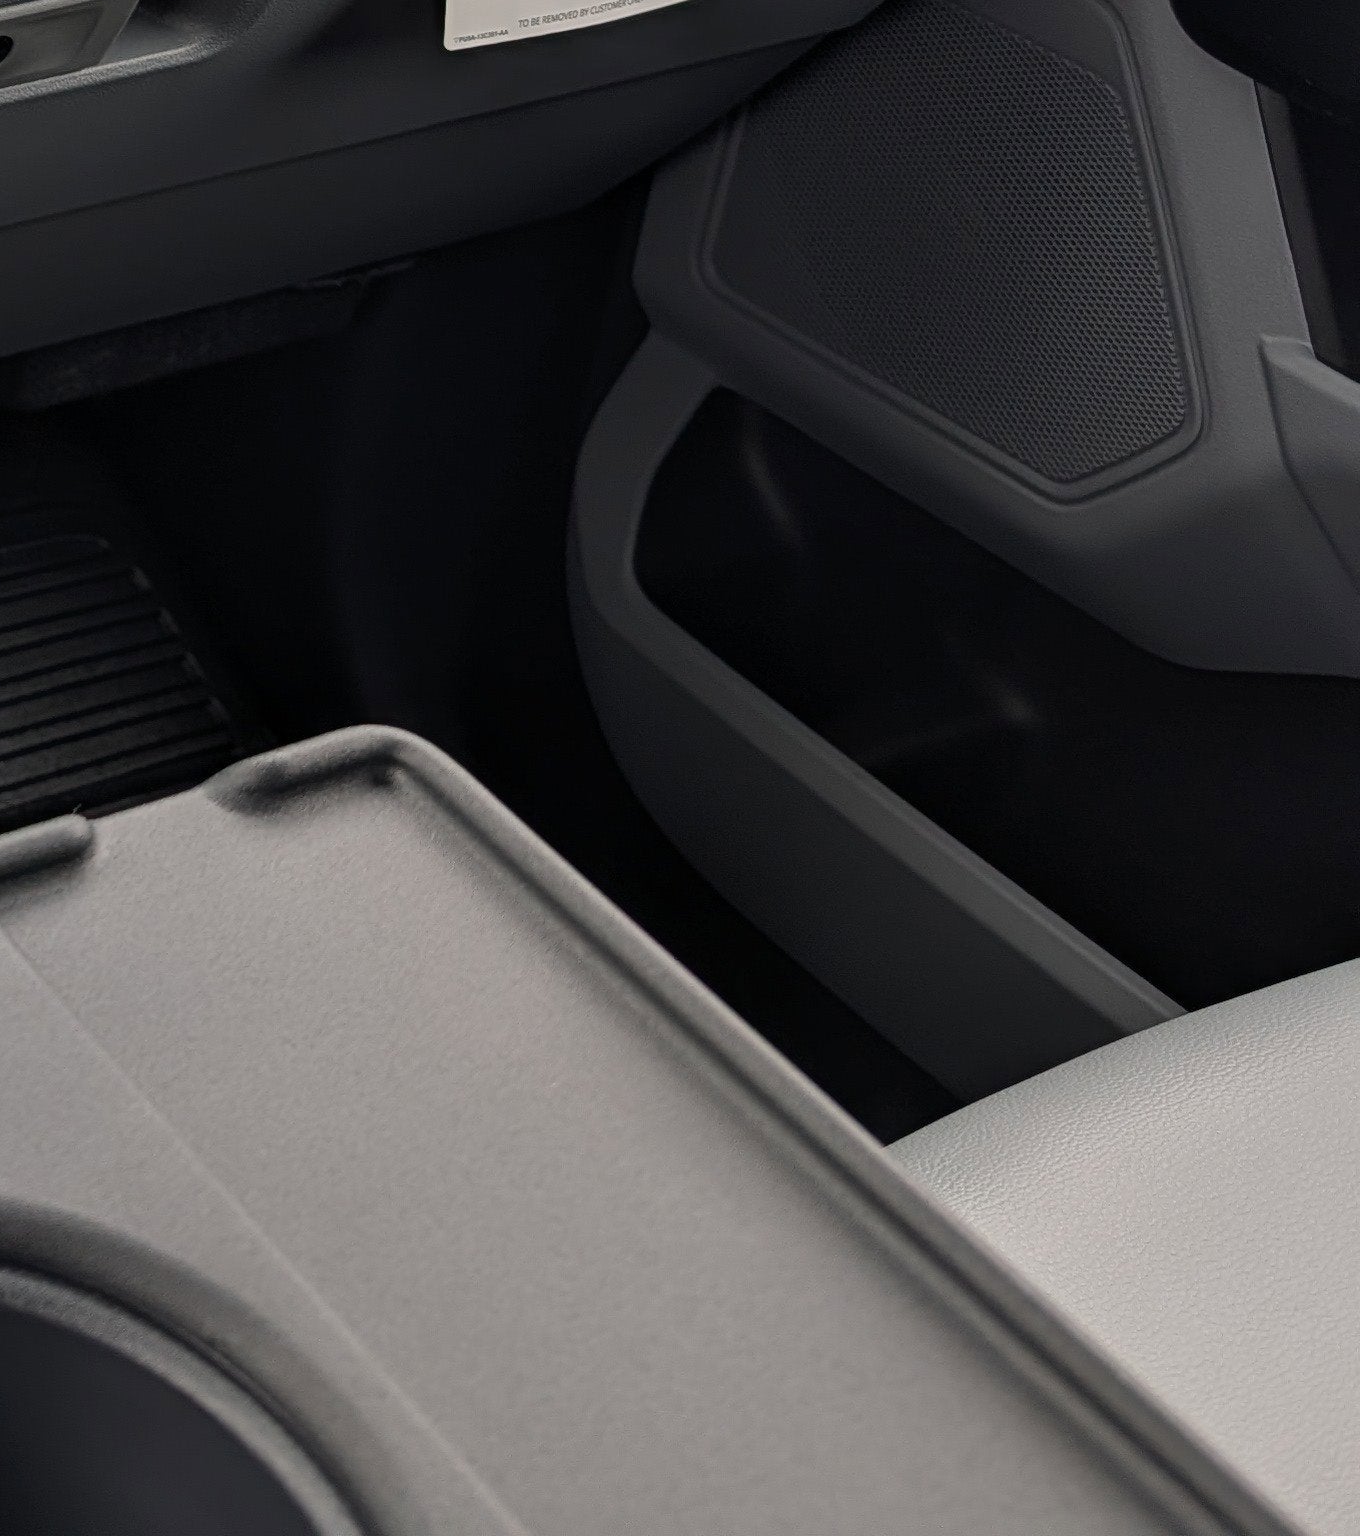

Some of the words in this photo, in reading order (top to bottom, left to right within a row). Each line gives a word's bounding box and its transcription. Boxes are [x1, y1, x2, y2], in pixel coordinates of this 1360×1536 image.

[518, 19, 529, 28] TO
[530, 17, 541, 26] BE
[542, 10, 579, 24] REMOVED
[579, 8, 589, 17] BY
[589, 0, 627, 15] CUSTOMER
